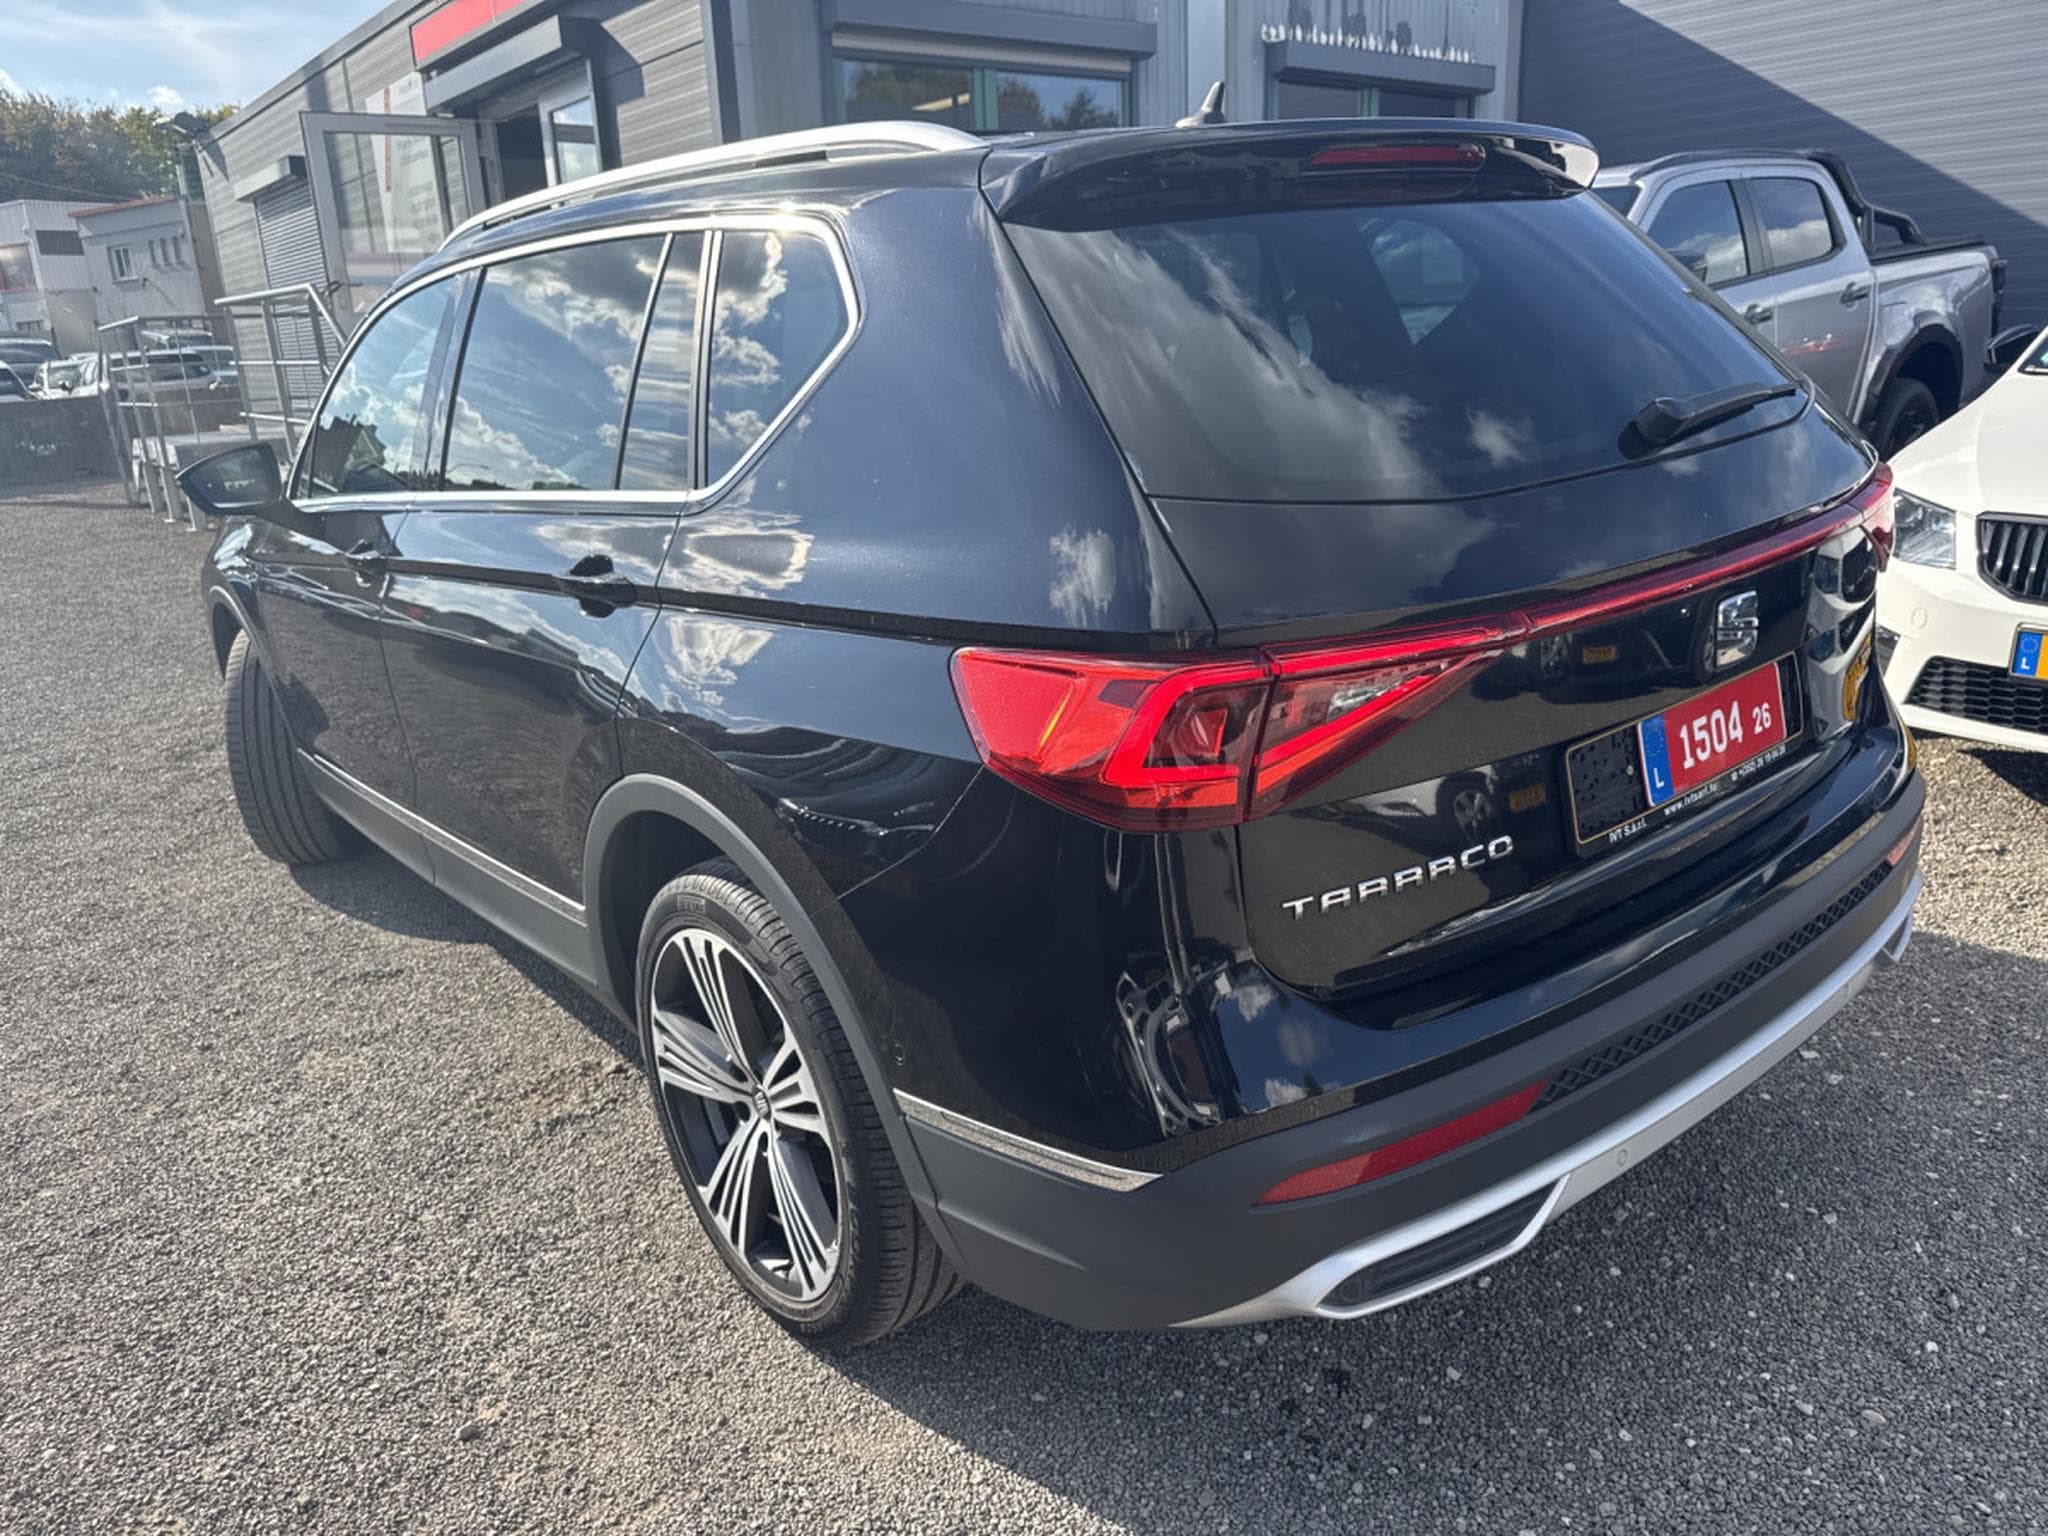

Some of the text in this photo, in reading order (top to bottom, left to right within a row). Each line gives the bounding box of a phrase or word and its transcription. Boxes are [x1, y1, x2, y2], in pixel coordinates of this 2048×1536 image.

[2020, 656, 2031, 671] L
[1653, 700, 1772, 789] L 1504 26
[1283, 834, 1514, 920] TARRACO
